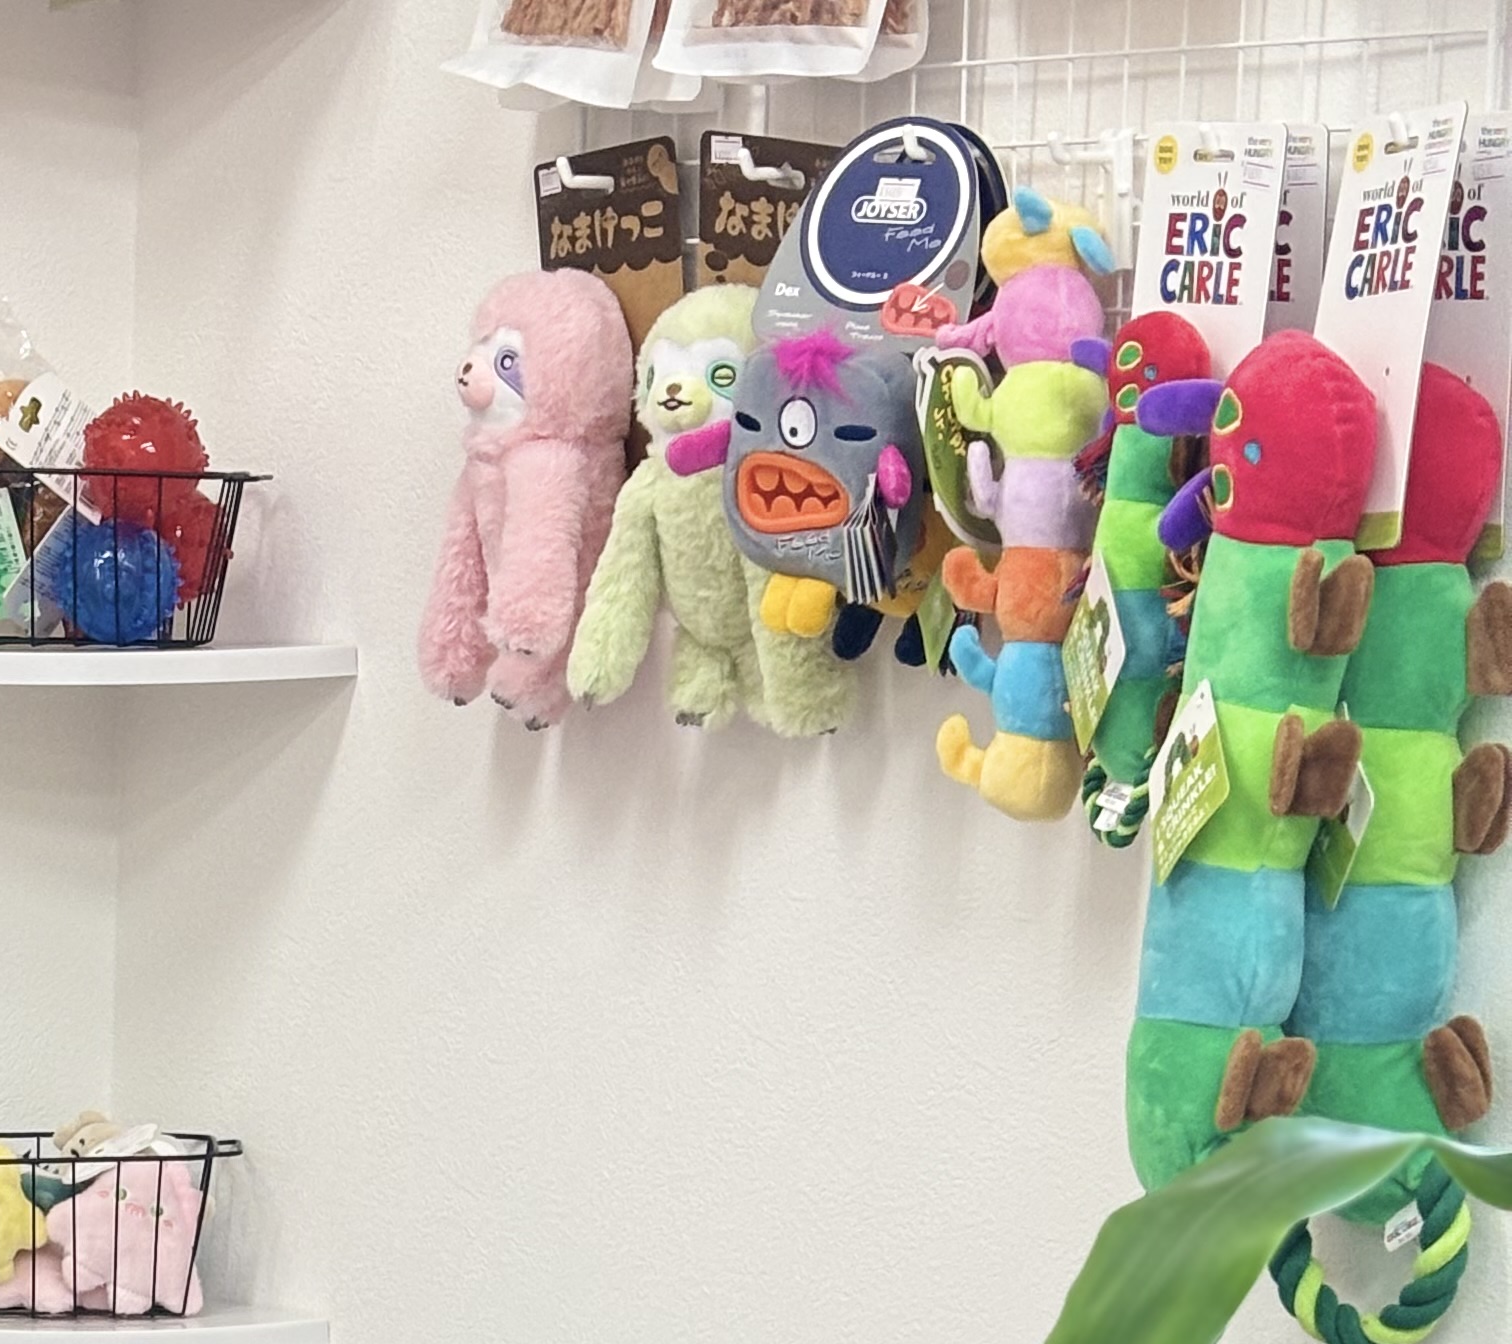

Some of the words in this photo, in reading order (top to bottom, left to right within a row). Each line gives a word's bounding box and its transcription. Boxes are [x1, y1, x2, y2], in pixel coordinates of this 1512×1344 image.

[1171, 190, 1210, 208] world
[1231, 192, 1246, 209] of
[1363, 181, 1395, 202] world
[1412, 179, 1424, 193] of
[1467, 184, 1484, 201] of
[714, 190, 801, 241] なまけ
[857, 200, 920, 220] JOYSER
[550, 199, 664, 260] なまけっこ
[884, 223, 936, 242] Feed
[906, 236, 942, 253] Me
[1160, 258, 1243, 306] CARLE
[1345, 245, 1417, 301] CARLE
[1434, 254, 1486, 301] RLE
[775, 282, 800, 298] Dex
